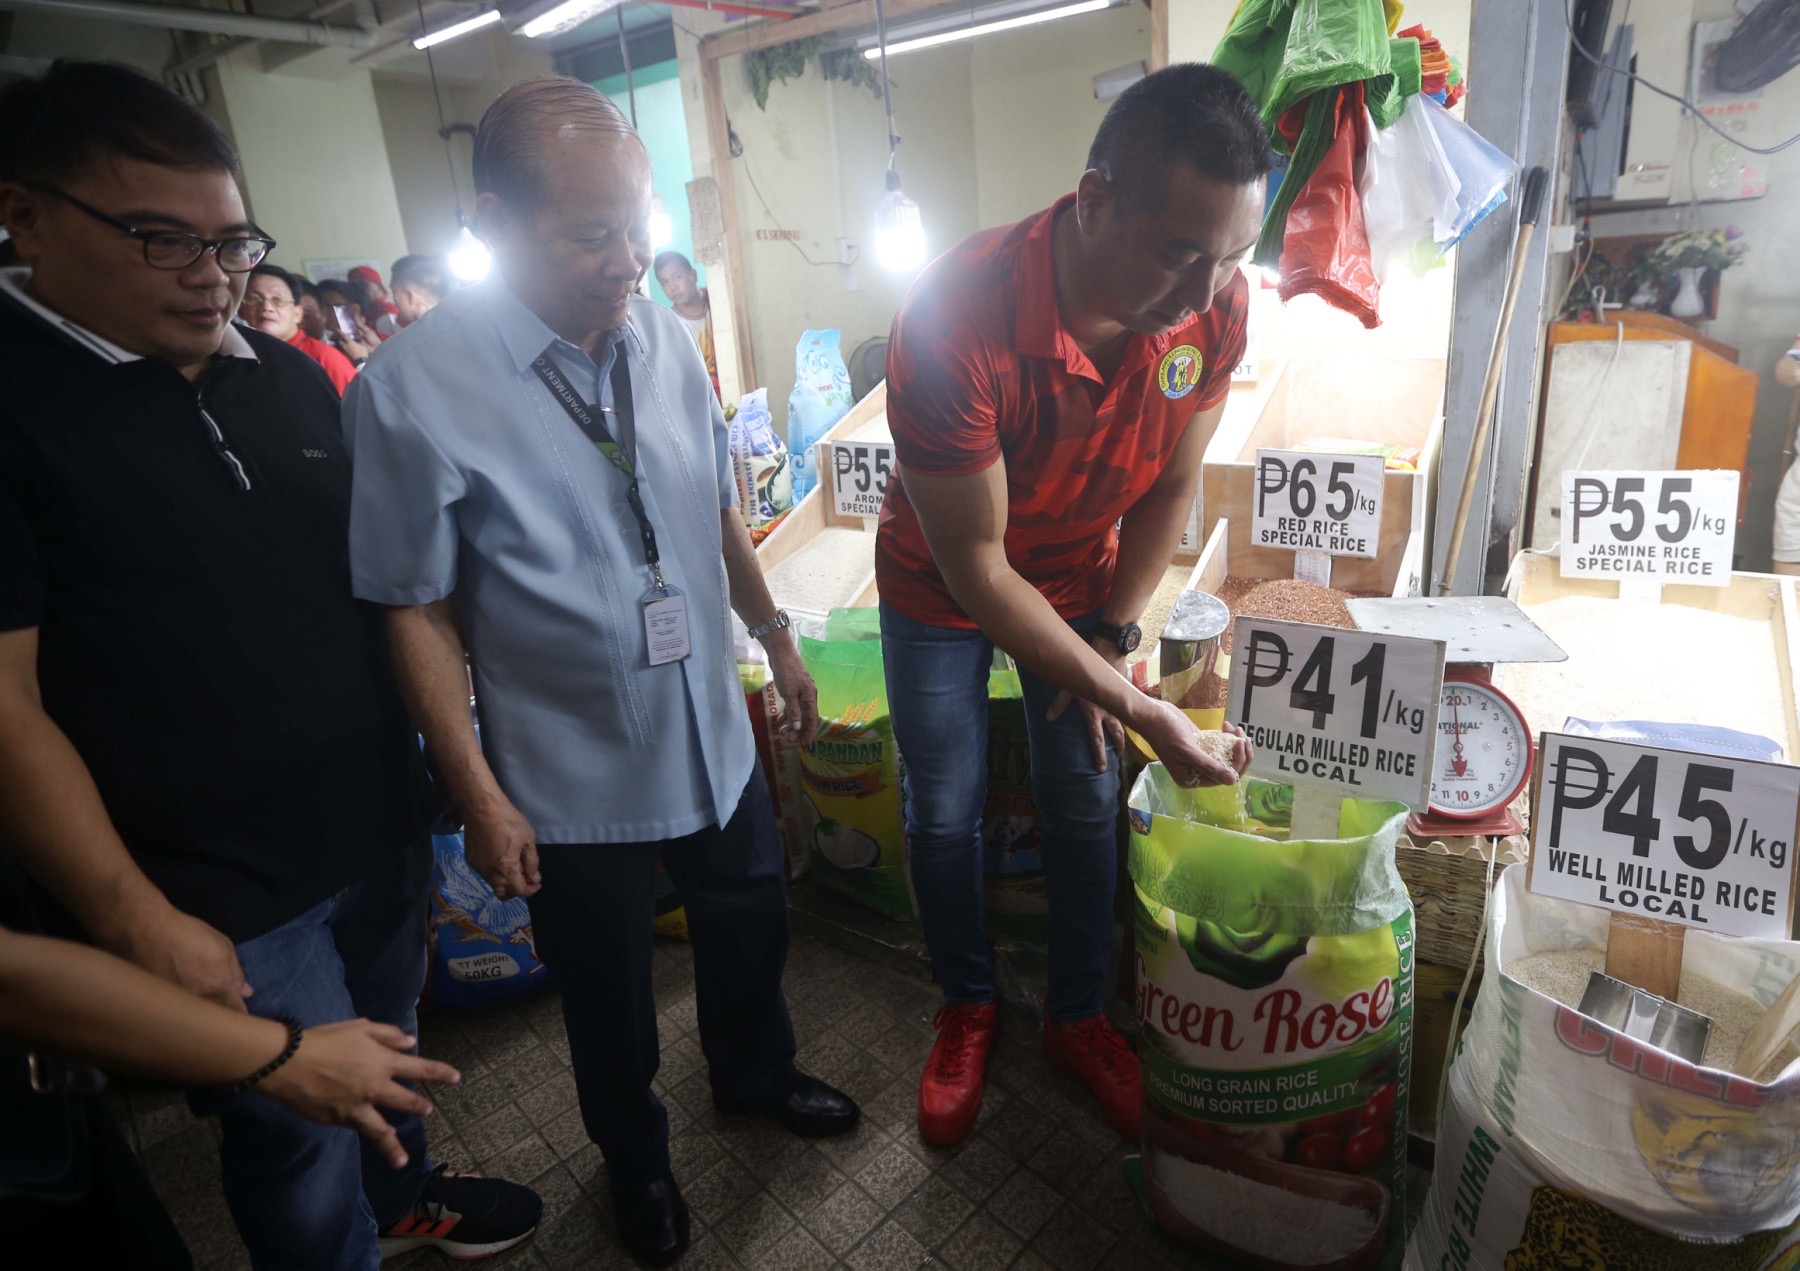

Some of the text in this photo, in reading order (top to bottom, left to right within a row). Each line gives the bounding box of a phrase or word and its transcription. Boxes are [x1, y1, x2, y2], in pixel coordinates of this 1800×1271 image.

[542, 367, 592, 425] DEPARTMENT
[841, 502, 880, 515] SPECIAL
[1278, 517, 1349, 536] RED RICE
[1261, 530, 1366, 552] SPECIAL RICE
[1588, 544, 1701, 559] JASMINE RICE
[1577, 557, 1713, 575] SPECIAL RICE
[1446, 696, 1462, 706] 20
[817, 740, 883, 765] PANDAN
[1310, 736, 1369, 768] MILLED
[1375, 749, 1416, 777] RICE
[1279, 755, 1362, 786] LOCAL
[1455, 790, 1469, 801] 10
[1549, 848, 1777, 916] WELL MILLED RICE
[1600, 885, 1708, 923] LOCAL
[465, 966, 501, 980] 50KG
[1397, 927, 1413, 1008] RICE
[1254, 978, 1390, 1054] Rose
[1150, 1073, 1360, 1115] PREMIUM SORTED QUALITY
[1172, 1069, 1319, 1094] LONG GRAIN RICE
[1454, 1125, 1501, 1238] WHITE
